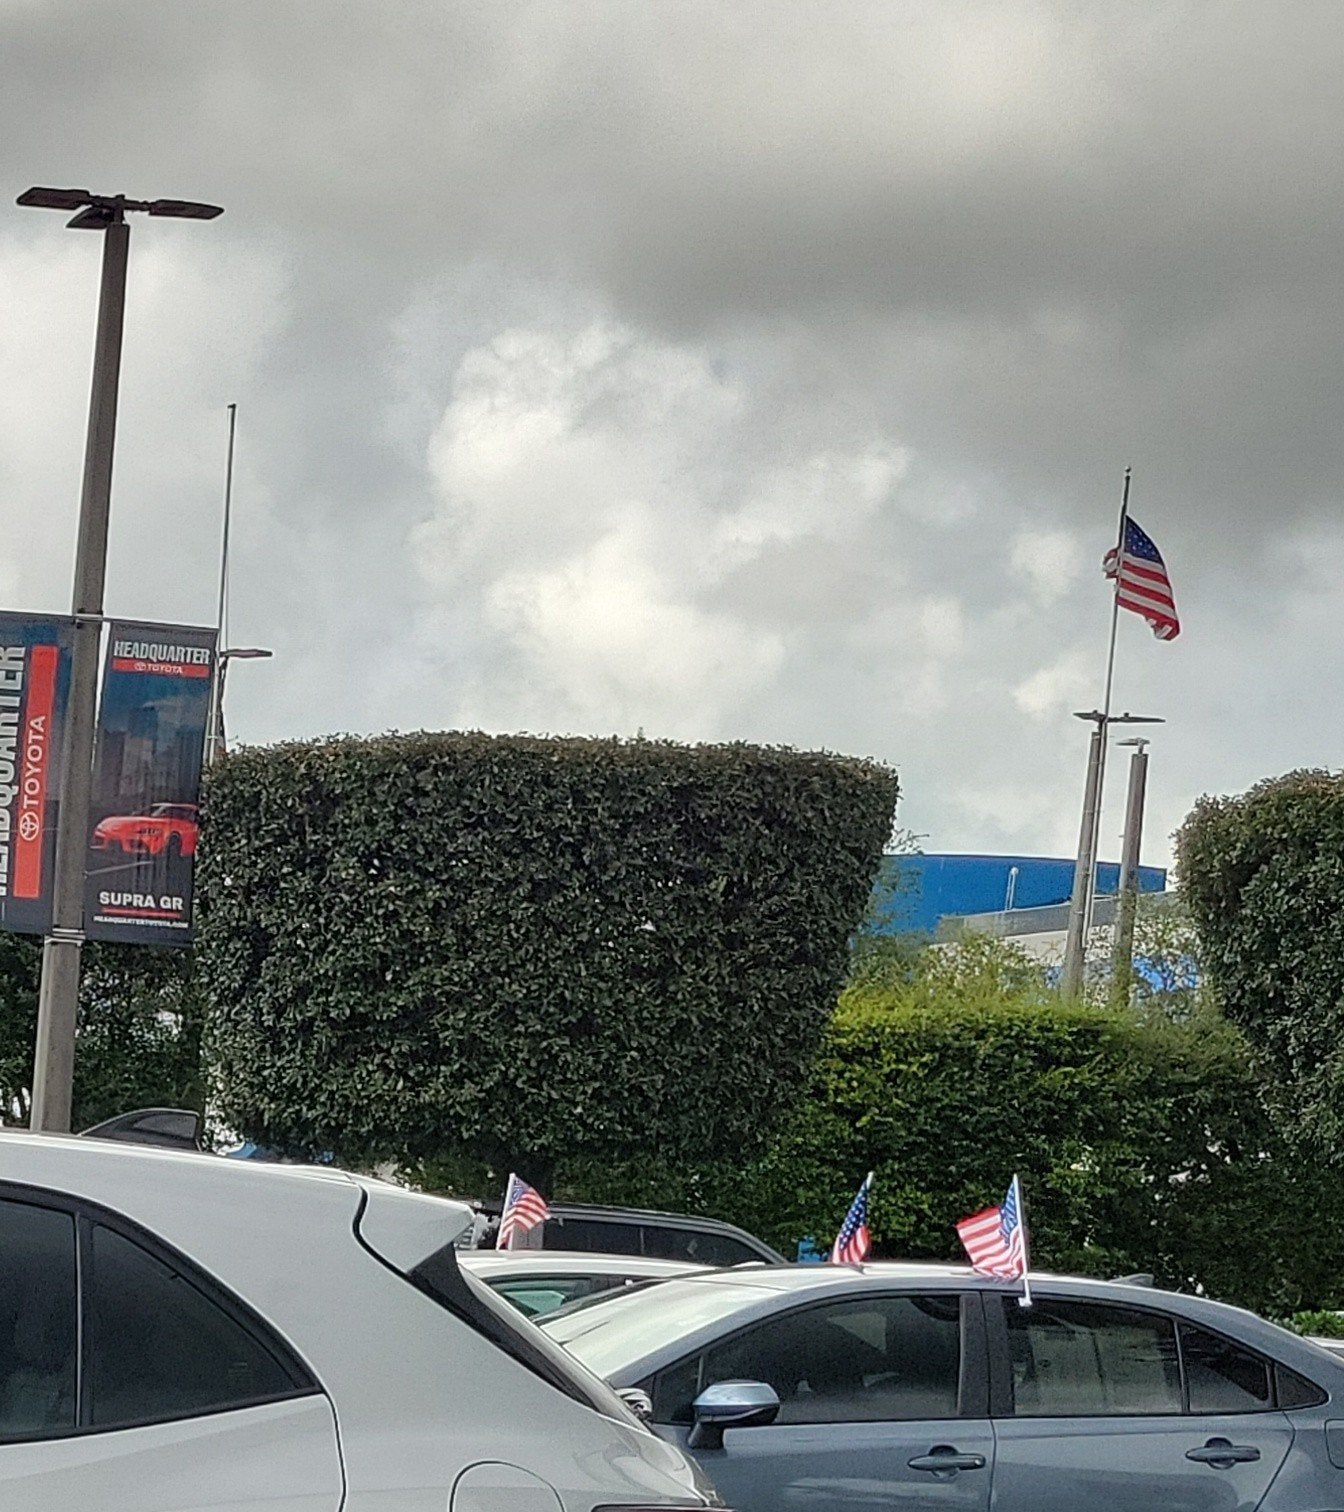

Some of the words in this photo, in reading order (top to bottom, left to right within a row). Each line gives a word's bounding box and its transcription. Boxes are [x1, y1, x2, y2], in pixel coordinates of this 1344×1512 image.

[113, 640, 211, 665] HEADQUARTER
[147, 662, 184, 675] TOYOTA
[22, 715, 46, 809] TOYOTA
[99, 891, 156, 909] SUPRA
[159, 895, 184, 911] GR
